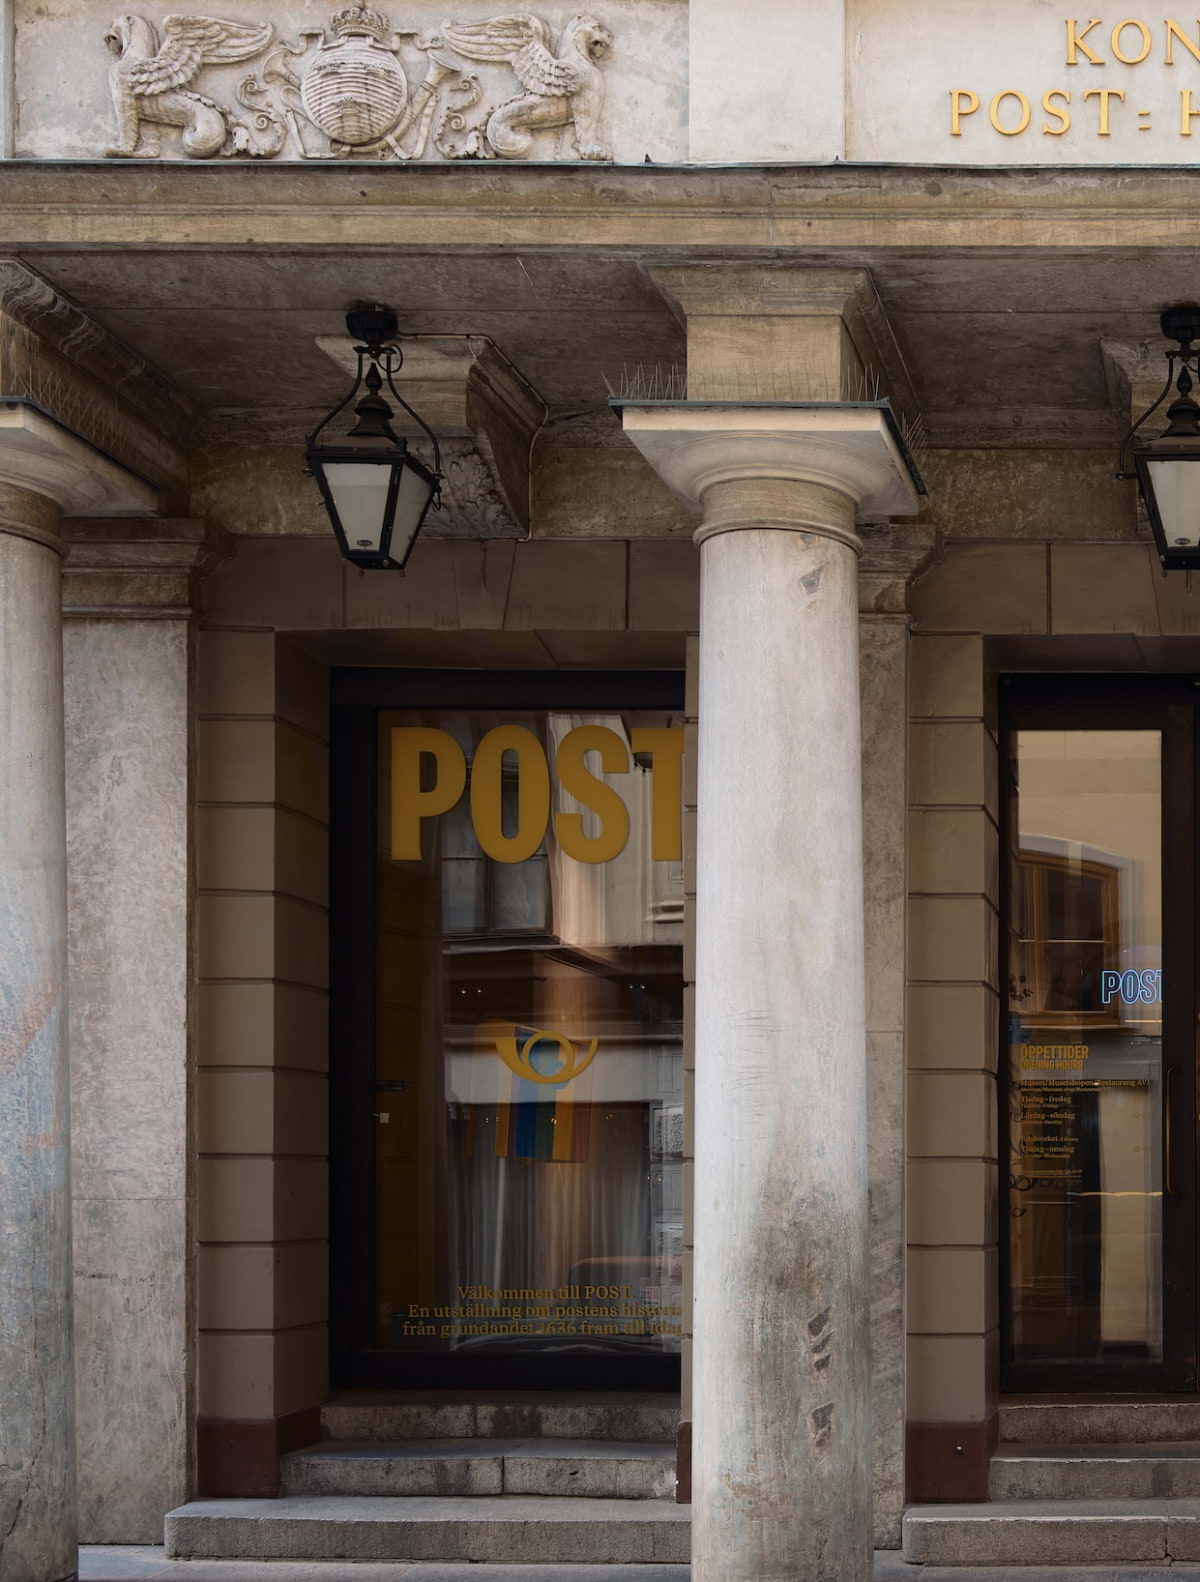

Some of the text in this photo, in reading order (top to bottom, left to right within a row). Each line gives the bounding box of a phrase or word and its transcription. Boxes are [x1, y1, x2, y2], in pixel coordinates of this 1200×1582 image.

[390, 724, 685, 865] POST
[458, 1285, 636, 1299] Välkommen till POST.
[408, 1304, 431, 1318] En
[434, 1303, 522, 1320] utställning
[526, 1307, 550, 1318] om
[556, 1305, 618, 1320] postens
[402, 1320, 436, 1336] från
[540, 1321, 577, 1336] 1636
[581, 1320, 619, 1336] fram
[624, 1319, 646, 1335] till
